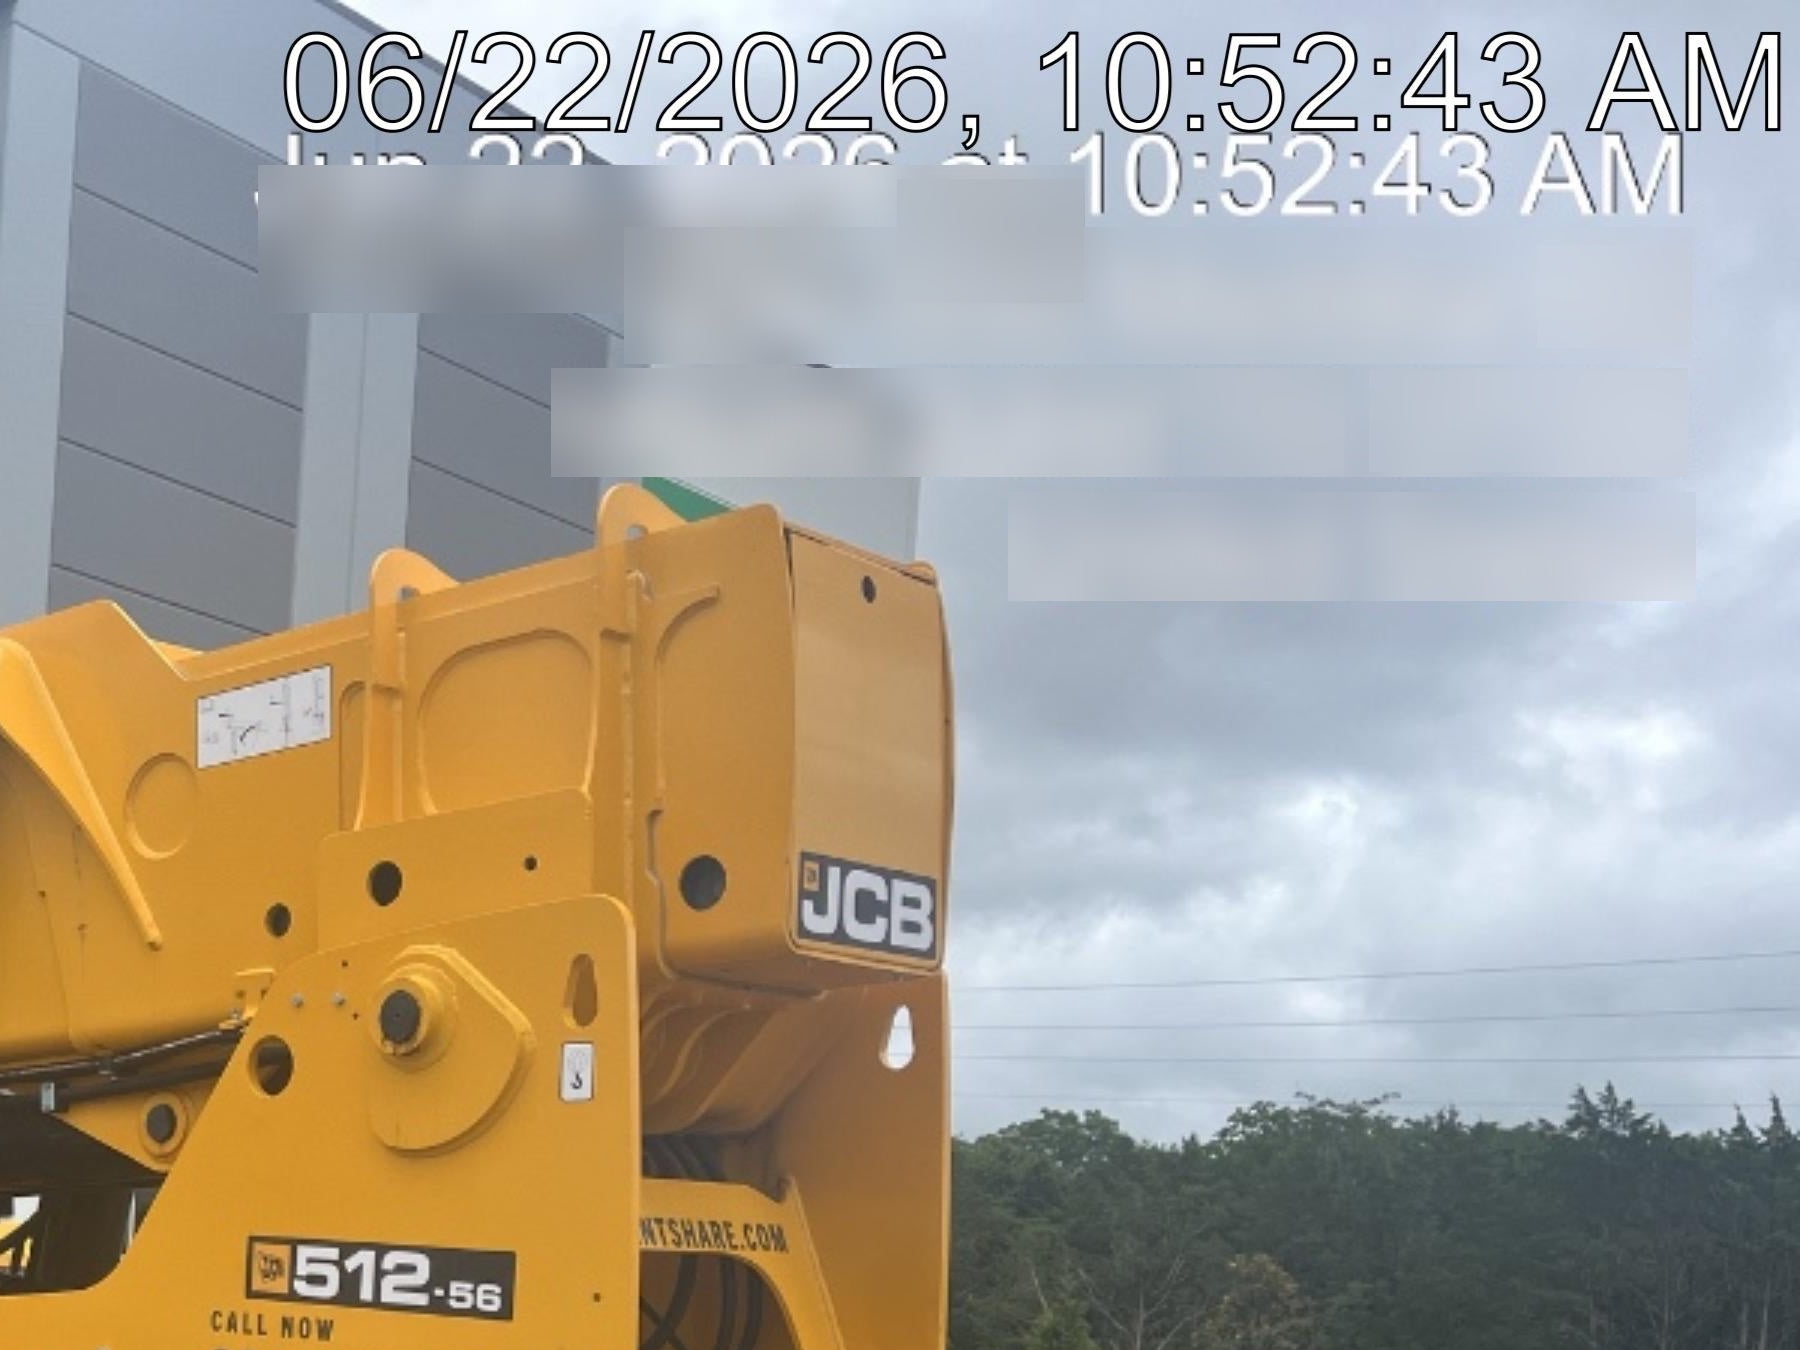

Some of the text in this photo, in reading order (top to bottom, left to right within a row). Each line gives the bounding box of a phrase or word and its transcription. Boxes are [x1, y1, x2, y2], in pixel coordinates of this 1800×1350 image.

[802, 866, 935, 951] JCB
[639, 1217, 790, 1253] NTSHARE.COM
[211, 1311, 334, 1342] CALL NOW
